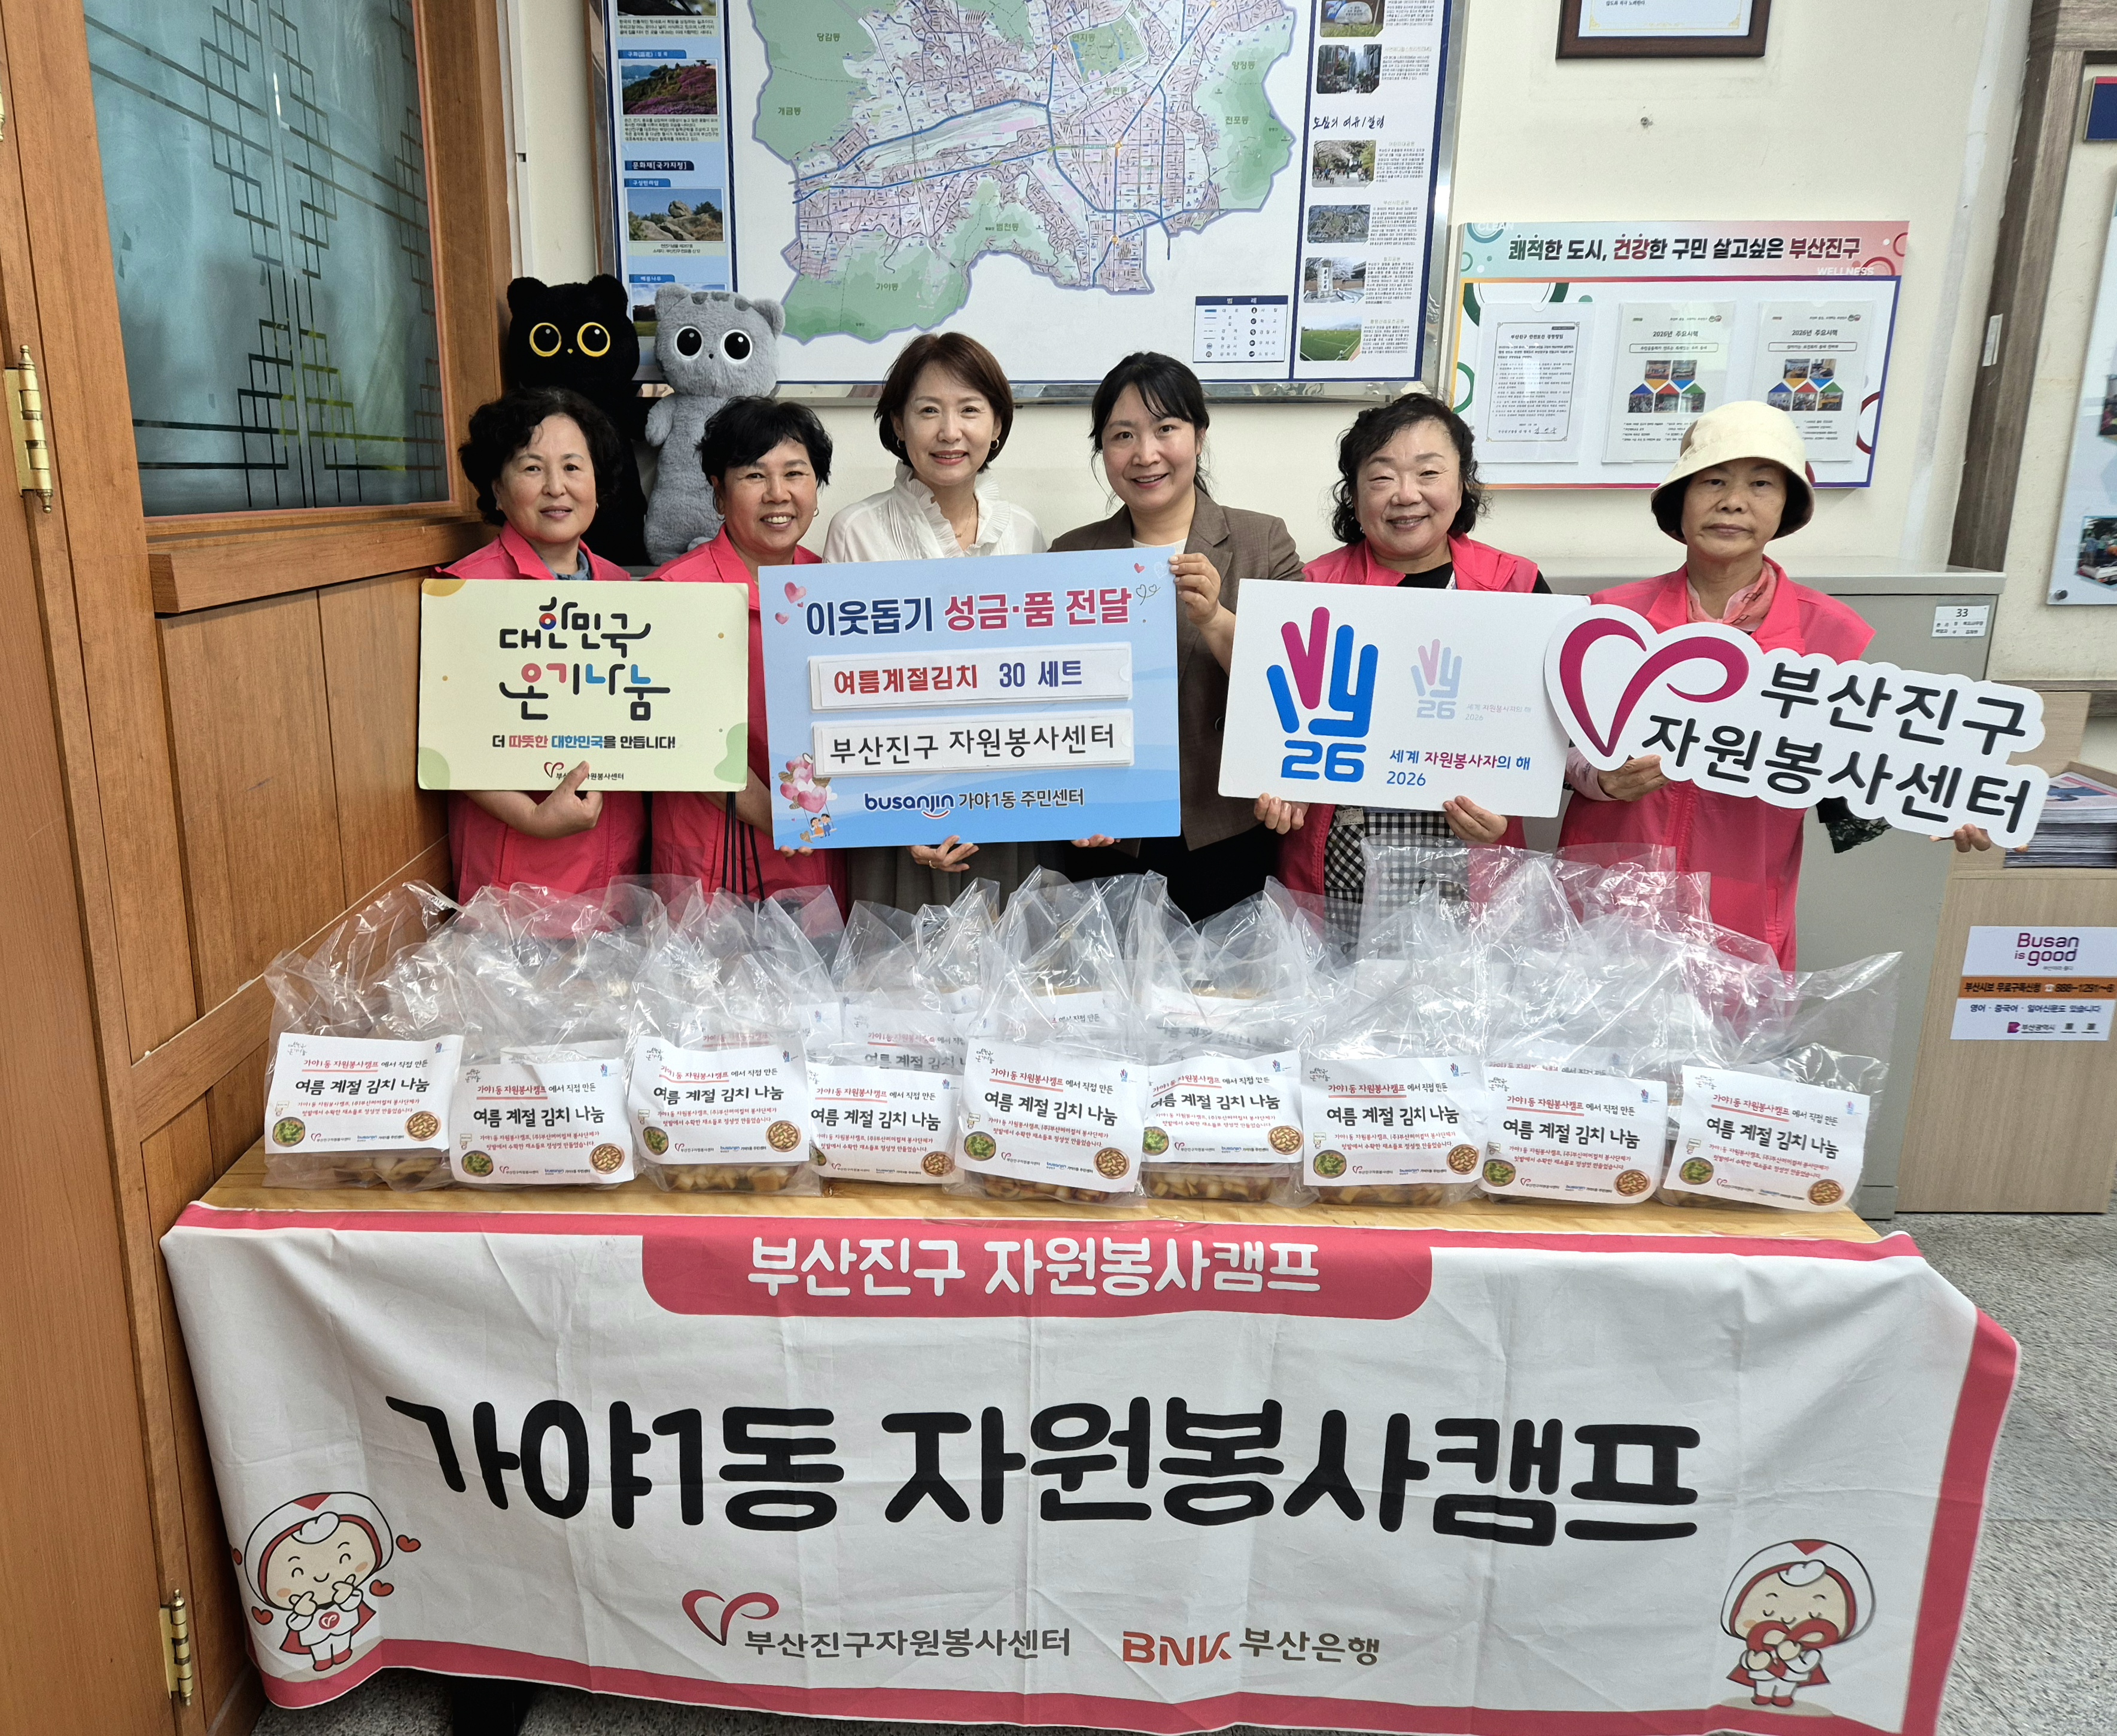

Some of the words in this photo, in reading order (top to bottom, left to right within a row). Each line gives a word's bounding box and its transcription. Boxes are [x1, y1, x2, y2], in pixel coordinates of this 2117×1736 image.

[817, 33, 840, 42] 당감동
[1231, 61, 1255, 69] 양정동
[778, 106, 801, 115] 개금동
[1225, 115, 1249, 125] 전포동
[632, 162, 687, 170] 문화재[국가지정]
[1508, 239, 1562, 261] 쾌적한
[1567, 239, 1608, 261] 도시,
[1614, 239, 1668, 260] 건강한
[1672, 238, 1707, 260] 구민
[1713, 238, 1784, 260] 살고싶은
[1788, 237, 1861, 260] 부산진구
[1817, 267, 1875, 276] WELLNESS
[806, 598, 933, 636] 이웃돕기
[944, 592, 1056, 631] 성금·품
[1066, 587, 1133, 625] 전달
[1955, 608, 1969, 617] 33
[500, 596, 651, 658] 대한민국
[834, 665, 978, 695] 여름계절김치
[999, 662, 1025, 687] 30
[1038, 660, 1082, 688] 세트
[499, 663, 671, 721] 온기나눔
[1416, 699, 1456, 720] 26
[1760, 662, 2025, 756] 부산진구
[492, 735, 505, 749] 더
[509, 735, 548, 748] 따뜻한
[551, 735, 616, 749] 대한민국을
[620, 736, 676, 749] 만듭니다!
[830, 735, 939, 765] 부산진구
[948, 723, 1115, 759] 자원봉사센터
[1280, 739, 1367, 782] 26
[1389, 750, 1419, 765] 세계
[1424, 751, 1511, 770] 자원봉사자의
[1515, 755, 1531, 771] 해
[1386, 770, 1426, 787] 2026
[1642, 714, 2031, 833] 자원봉사센터
[958, 791, 1017, 811] 가야1동
[1020, 788, 1084, 808] 주민센터
[2017, 933, 2079, 948] Busan
[2014, 951, 2025, 960] is
[2027, 949, 2078, 967] good
[334, 1060, 379, 1069] 자원봉사캠프
[415, 1059, 428, 1068] 만든
[296, 1079, 324, 1095] 여름
[330, 1080, 360, 1095] 계절
[367, 1078, 396, 1094] 김치
[401, 1077, 429, 1092] 나눔
[685, 1071, 729, 1080] 자원봉사캠프
[1020, 1072, 1063, 1087] 자원봉사캠프
[1066, 1080, 1080, 1089] 에서
[1082, 1083, 1097, 1092] 직접
[1099, 1085, 1113, 1094] 만든
[504, 1085, 546, 1095] 자원봉사캠프
[567, 1083, 580, 1093] 직접
[582, 1083, 596, 1092] 만든
[653, 1088, 680, 1105] 여름
[686, 1089, 715, 1103] 계절
[721, 1088, 749, 1102] 김치
[755, 1086, 784, 1100] 나눔
[844, 1088, 887, 1098] 자원봉사캠프
[1359, 1085, 1406, 1094] 자원봉사캠프
[1422, 1083, 1434, 1092] 직접
[1435, 1083, 1448, 1092] 만든
[985, 1091, 1013, 1112] 여름
[1018, 1096, 1048, 1117] 계절
[1054, 1102, 1082, 1120] 김치
[1088, 1106, 1118, 1126] 나눔
[1151, 1094, 1176, 1108] 여름
[1181, 1094, 1211, 1109] 계절
[1216, 1095, 1245, 1110] 김치
[1250, 1095, 1280, 1109] 나눔
[1538, 1098, 1583, 1111] 자원봉사캠프
[1603, 1105, 1618, 1115] 직접
[1620, 1107, 1635, 1116] 만든
[474, 1108, 502, 1128] 여름
[506, 1108, 536, 1127] 계절
[541, 1107, 569, 1126] 김치
[576, 1105, 605, 1123] 나눔
[811, 1108, 839, 1126] 여름
[844, 1110, 873, 1128] 계절
[879, 1111, 907, 1129] 김치
[912, 1111, 941, 1131] 나눔
[1327, 1107, 1358, 1126] 여름
[1362, 1107, 1394, 1126] 계절
[1400, 1106, 1425, 1126] 김치
[1430, 1105, 1459, 1123] 나눔
[1743, 1100, 1789, 1116] 자원봉사캠프
[1792, 1110, 1807, 1119] 에서
[1809, 1113, 1823, 1124] 직접
[1824, 1116, 1838, 1126] 만든
[1503, 1119, 1534, 1140] 여름
[1539, 1122, 1570, 1144] 계절
[1575, 1125, 1604, 1145] 김치
[1610, 1129, 1640, 1149] 나눔
[1707, 1118, 1735, 1140] 여름
[1740, 1125, 1772, 1147] 계절
[1777, 1131, 1807, 1151] 김치
[1811, 1138, 1839, 1159] 나눔
[747, 1236, 966, 1297] 부산진구
[983, 1236, 1322, 1296] 자원봉사캠프
[385, 1394, 844, 1533] 가야1동
[883, 1396, 1702, 1546] 자원봉사캠프
[745, 1627, 1070, 1661] 부산진구자원봉사센터
[1123, 1630, 1233, 1666] BNK
[1239, 1628, 1380, 1667] 부산은행
